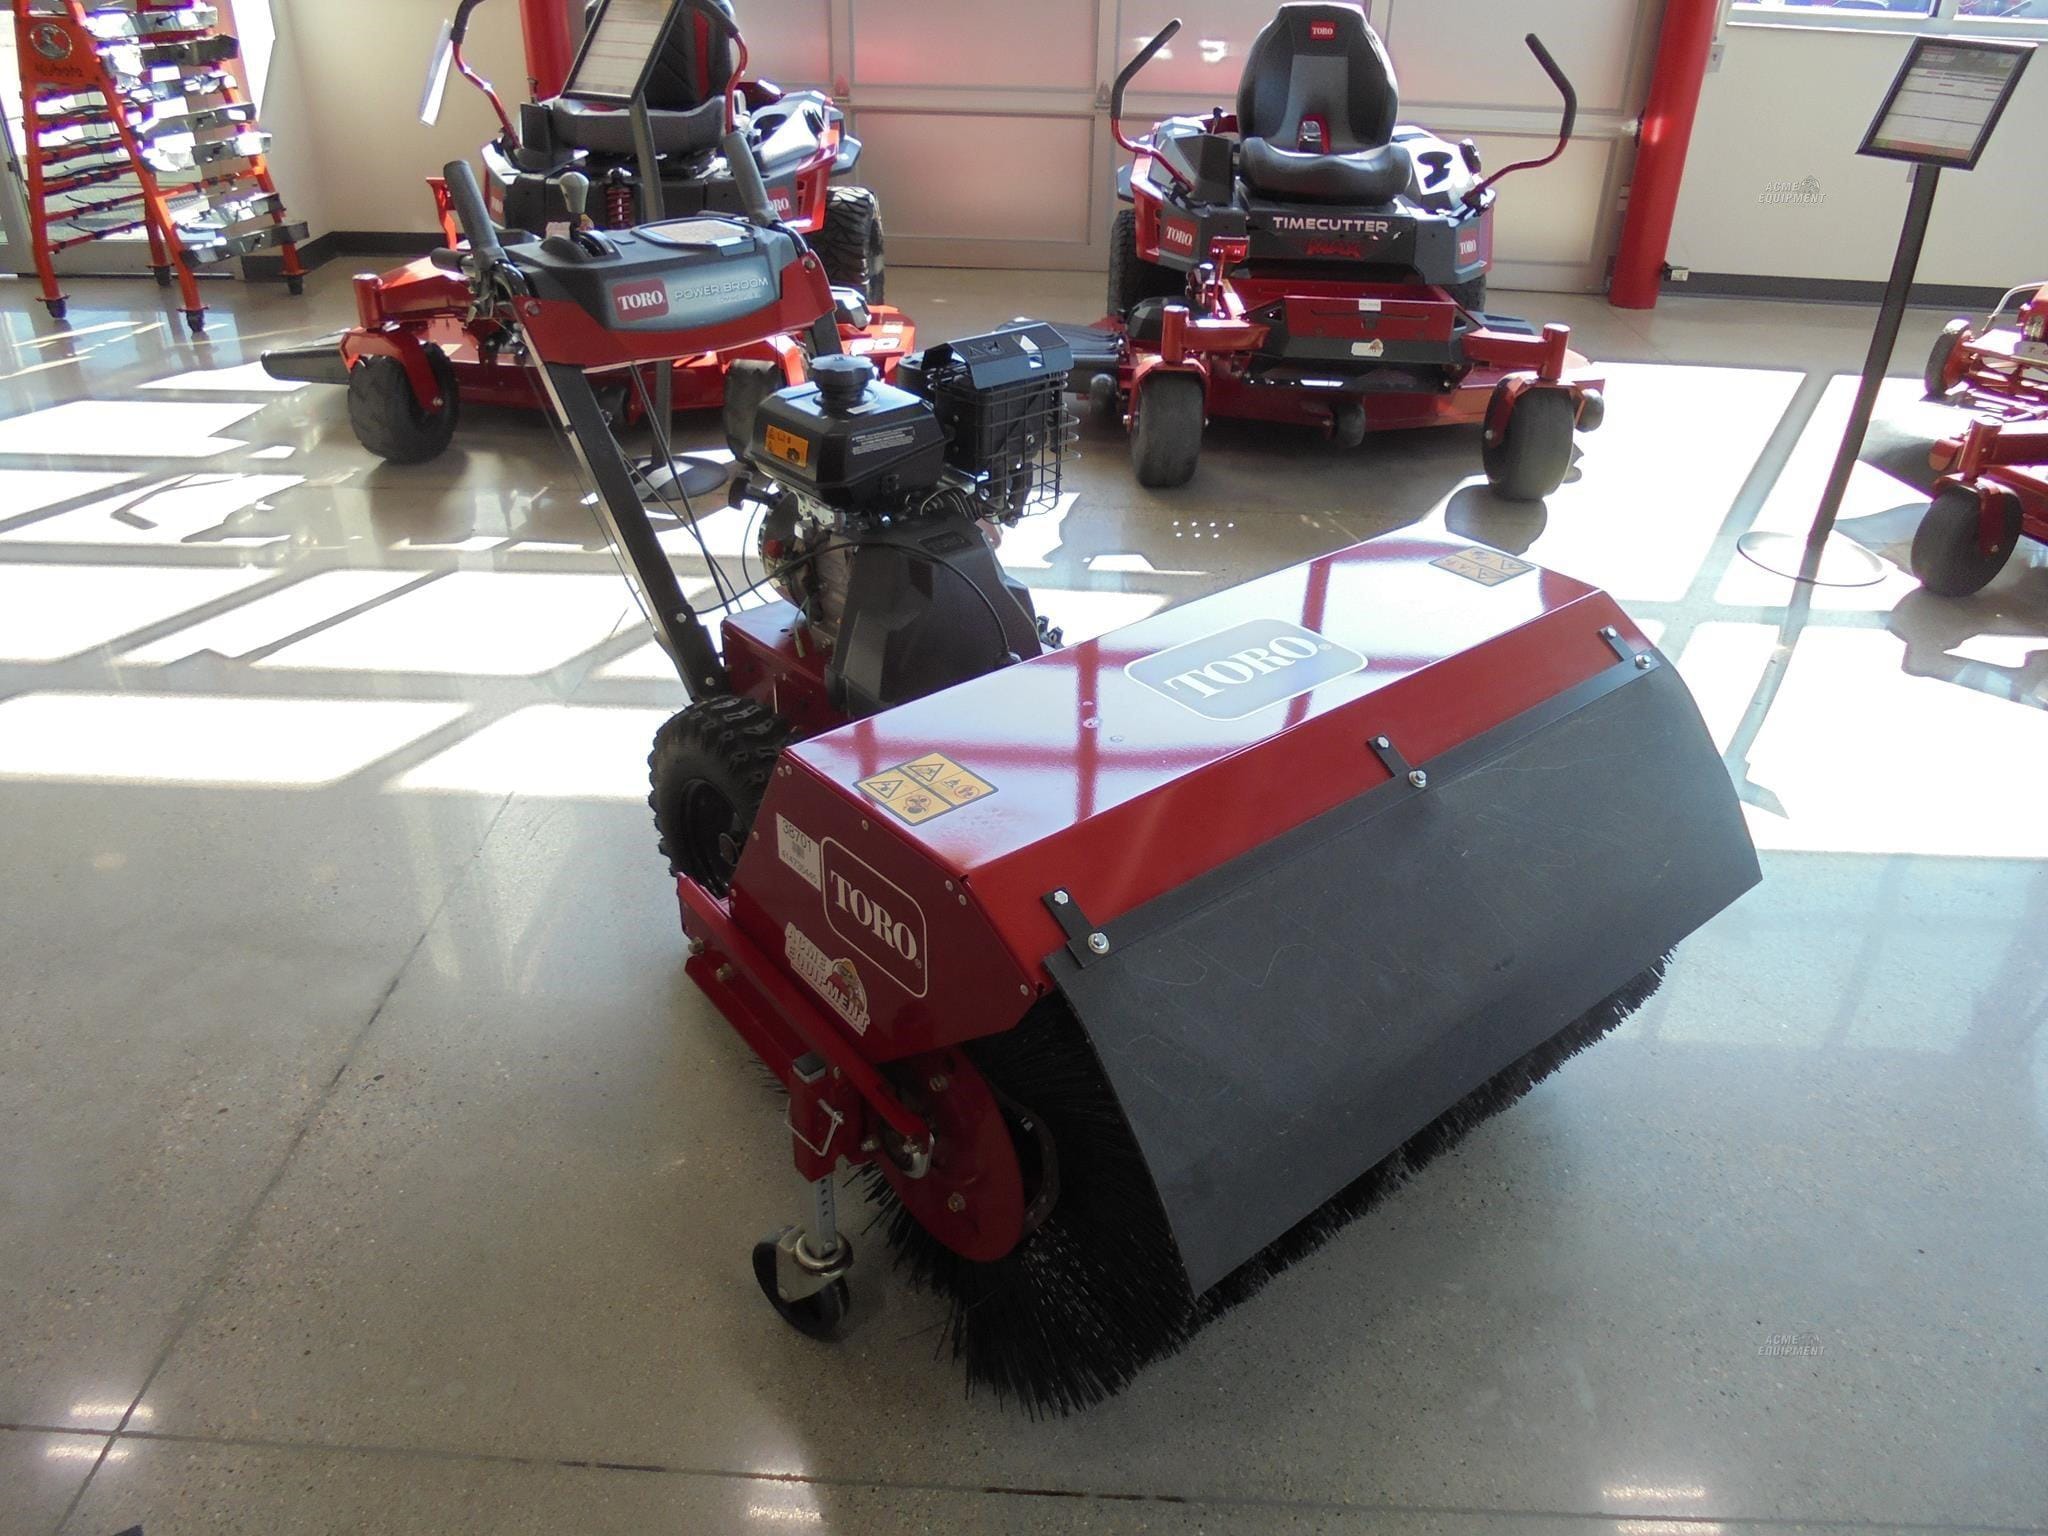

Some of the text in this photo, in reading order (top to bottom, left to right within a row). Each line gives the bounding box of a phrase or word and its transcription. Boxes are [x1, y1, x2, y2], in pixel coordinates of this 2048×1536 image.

[1312, 27, 1333, 35] TORO
[1167, 226, 1193, 246] TORO
[1273, 216, 1389, 232] TIMECUTTER
[1460, 240, 1477, 254] TORO
[617, 277, 769, 310] TORO POWER BROOM
[1163, 636, 1318, 699] TORO
[782, 820, 812, 853] 38701
[830, 870, 917, 961] TORO
[786, 923, 829, 972] ACME
[788, 944, 869, 1032] EQUIPMENT
